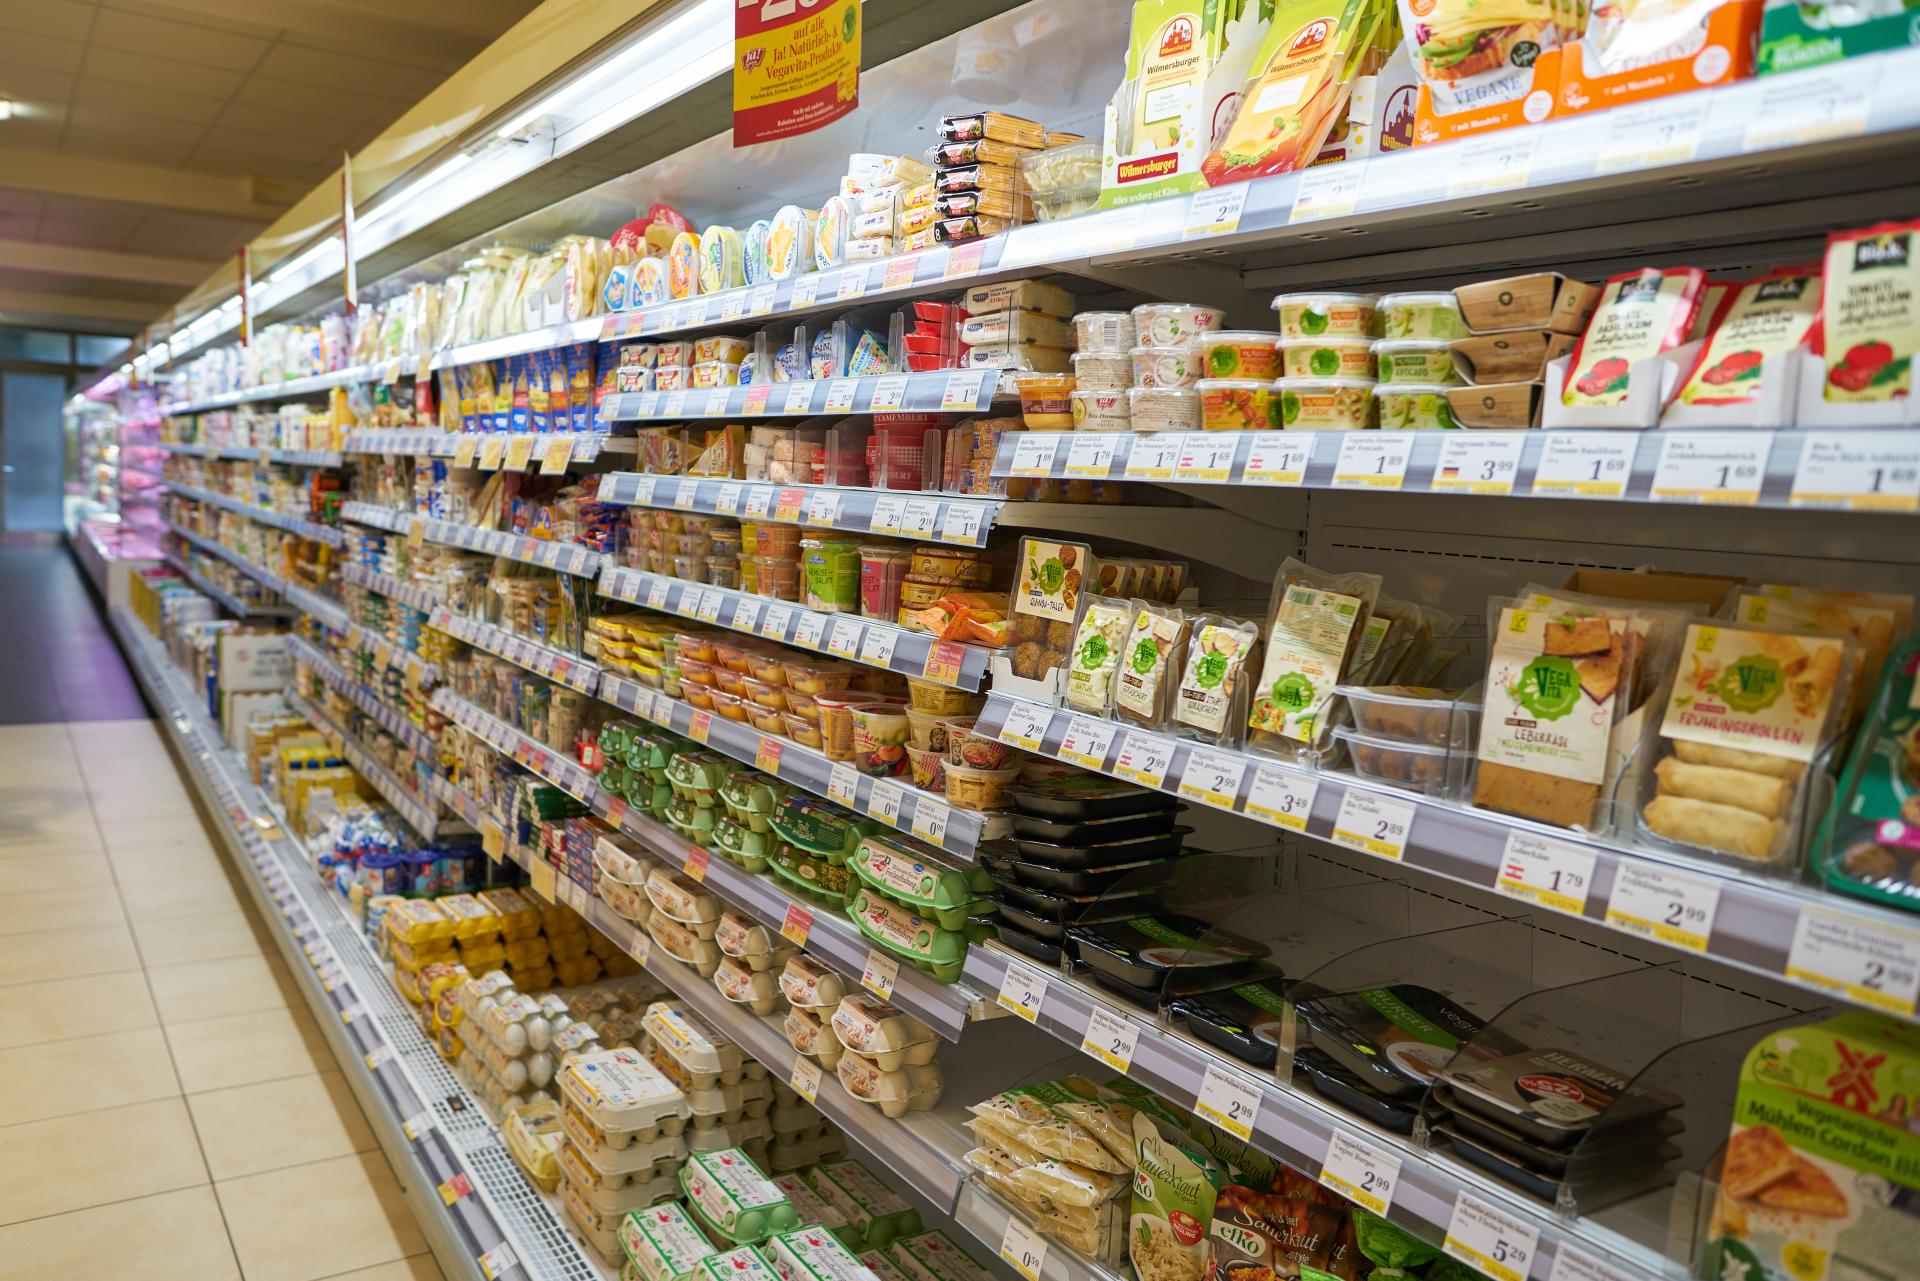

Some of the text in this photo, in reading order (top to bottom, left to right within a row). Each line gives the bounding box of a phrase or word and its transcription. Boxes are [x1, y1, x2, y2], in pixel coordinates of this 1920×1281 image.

[793, 16, 825, 40] auf alle
[773, 25, 839, 63] Ja! Natürlich- &
[766, 41, 843, 80] Vegavita-Produkte
[1147, 55, 1200, 75] Wilmersburger
[1270, 53, 1327, 73] Wilmersburger
[1453, 76, 1521, 105] VEGANE
[1119, 157, 1177, 179] Wilmersburger
[1112, 186, 1181, 207] Alles andere ist Käse.
[1024, 723, 1044, 739] 299
[1679, 711, 1804, 745] FRÜHLINGSROLLEN
[1086, 741, 1106, 756] 199
[1143, 756, 1166, 773] 299
[1211, 775, 1237, 793] 299
[1281, 794, 1308, 812] 349
[1373, 820, 1405, 840] 289
[1550, 869, 1584, 893] 179
[1664, 901, 1707, 928] 299
[1021, 991, 1040, 1008] 299
[1371, 987, 1434, 1034] BURGER
[1110, 1037, 1131, 1056] 299
[1228, 1100, 1253, 1120] 299
[1750, 1099, 1893, 1169] Mühlen Cordon
[1137, 1136, 1201, 1200] Sauerkraut
[1360, 1170, 1391, 1193] 299
[1220, 1225, 1260, 1254] efko
[1493, 1239, 1527, 1263] 529
